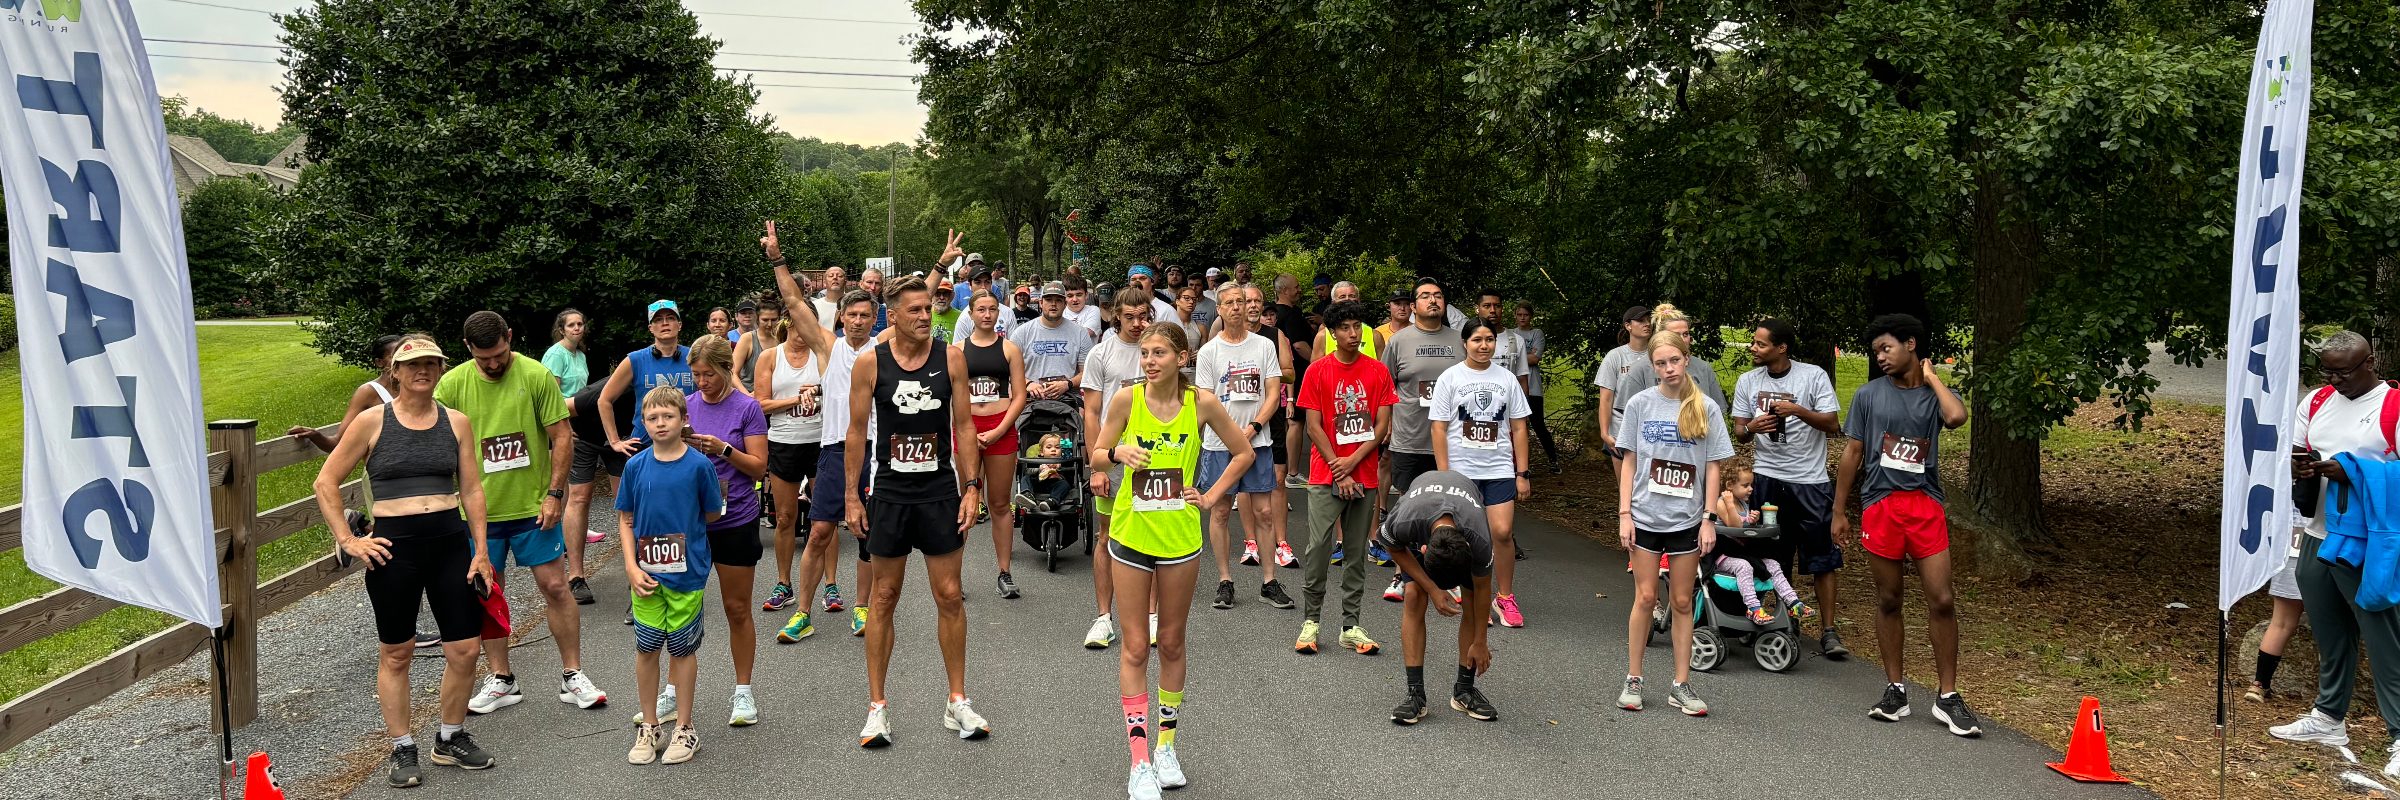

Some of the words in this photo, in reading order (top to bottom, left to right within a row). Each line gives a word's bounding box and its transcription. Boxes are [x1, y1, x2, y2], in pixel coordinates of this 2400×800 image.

[1415, 347, 1445, 356] KNIGHTS
[970, 381, 996, 396] 1082
[1233, 379, 1258, 393] 1062
[1343, 417, 1366, 434] 402
[1470, 426, 1491, 441] 303
[487, 439, 524, 462] 1272
[896, 442, 933, 461] 1242
[1891, 442, 1920, 462] 422
[1656, 466, 1690, 487] 1089
[1143, 477, 1171, 499] 401
[1425, 484, 1443, 493] OF
[643, 543, 680, 563] 1090
